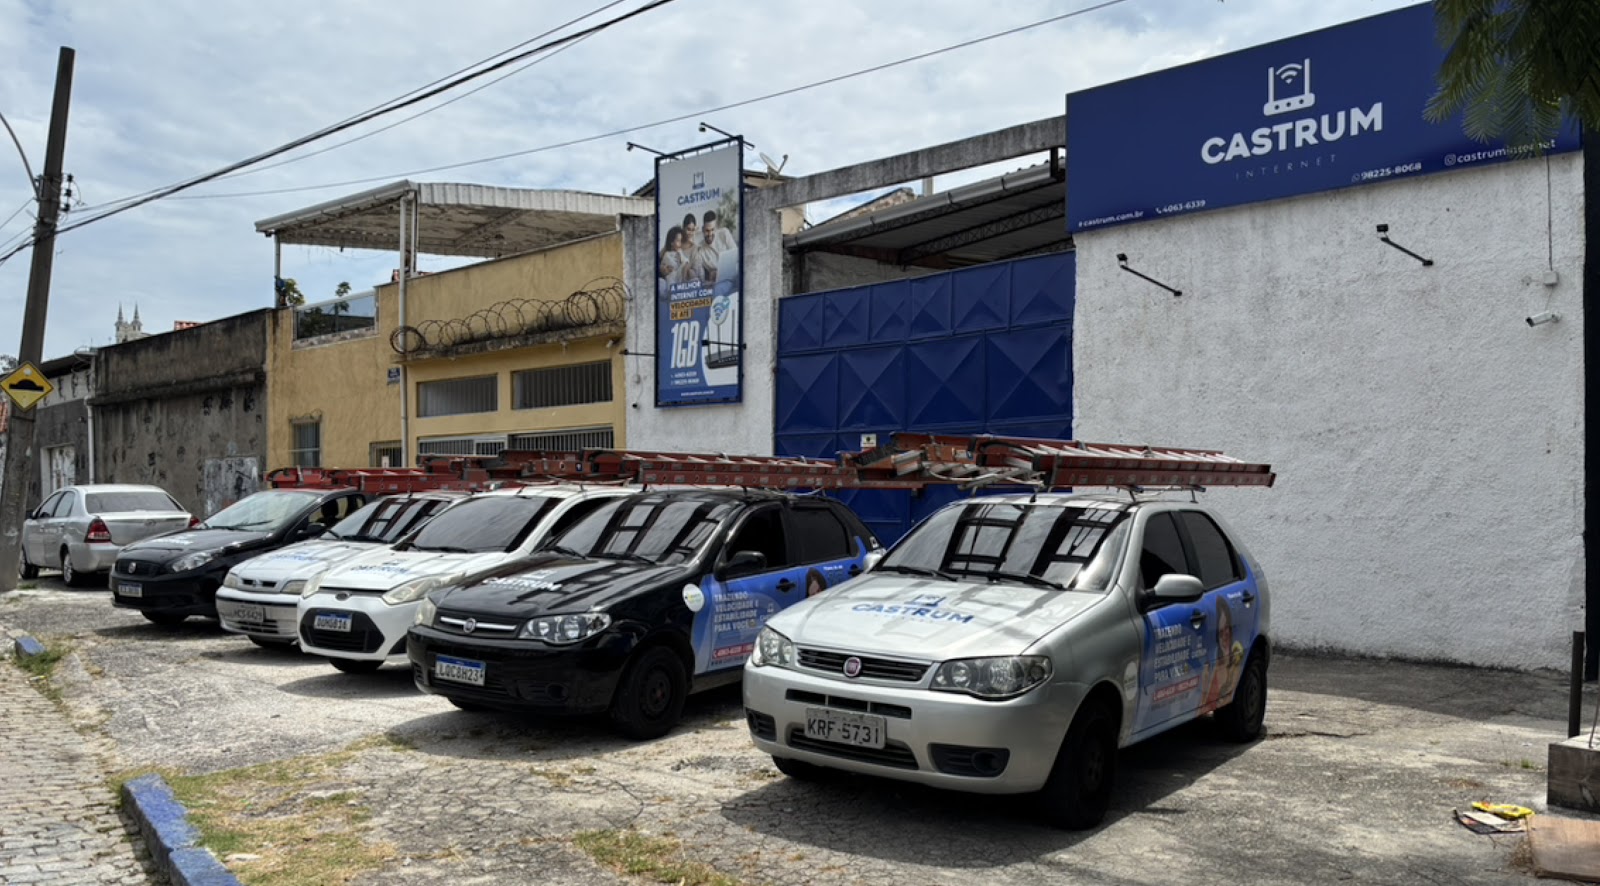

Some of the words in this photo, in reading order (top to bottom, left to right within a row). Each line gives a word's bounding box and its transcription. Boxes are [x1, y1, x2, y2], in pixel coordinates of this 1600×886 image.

[1201, 102, 1382, 164] CASTRUM
[1235, 155, 1336, 181] INTERNET
[1361, 162, 1422, 180] 98225-8068
[677, 187, 720, 206] CASTRUM
[1163, 200, 1206, 213] 4063-6339
[1083, 210, 1144, 227] castrum.com.br
[677, 280, 701, 290] MELHOR
[671, 290, 698, 300] INTERNET
[671, 320, 700, 368] 1GB
[714, 591, 749, 602] TRAZENDO
[852, 603, 974, 623] CASTRUM
